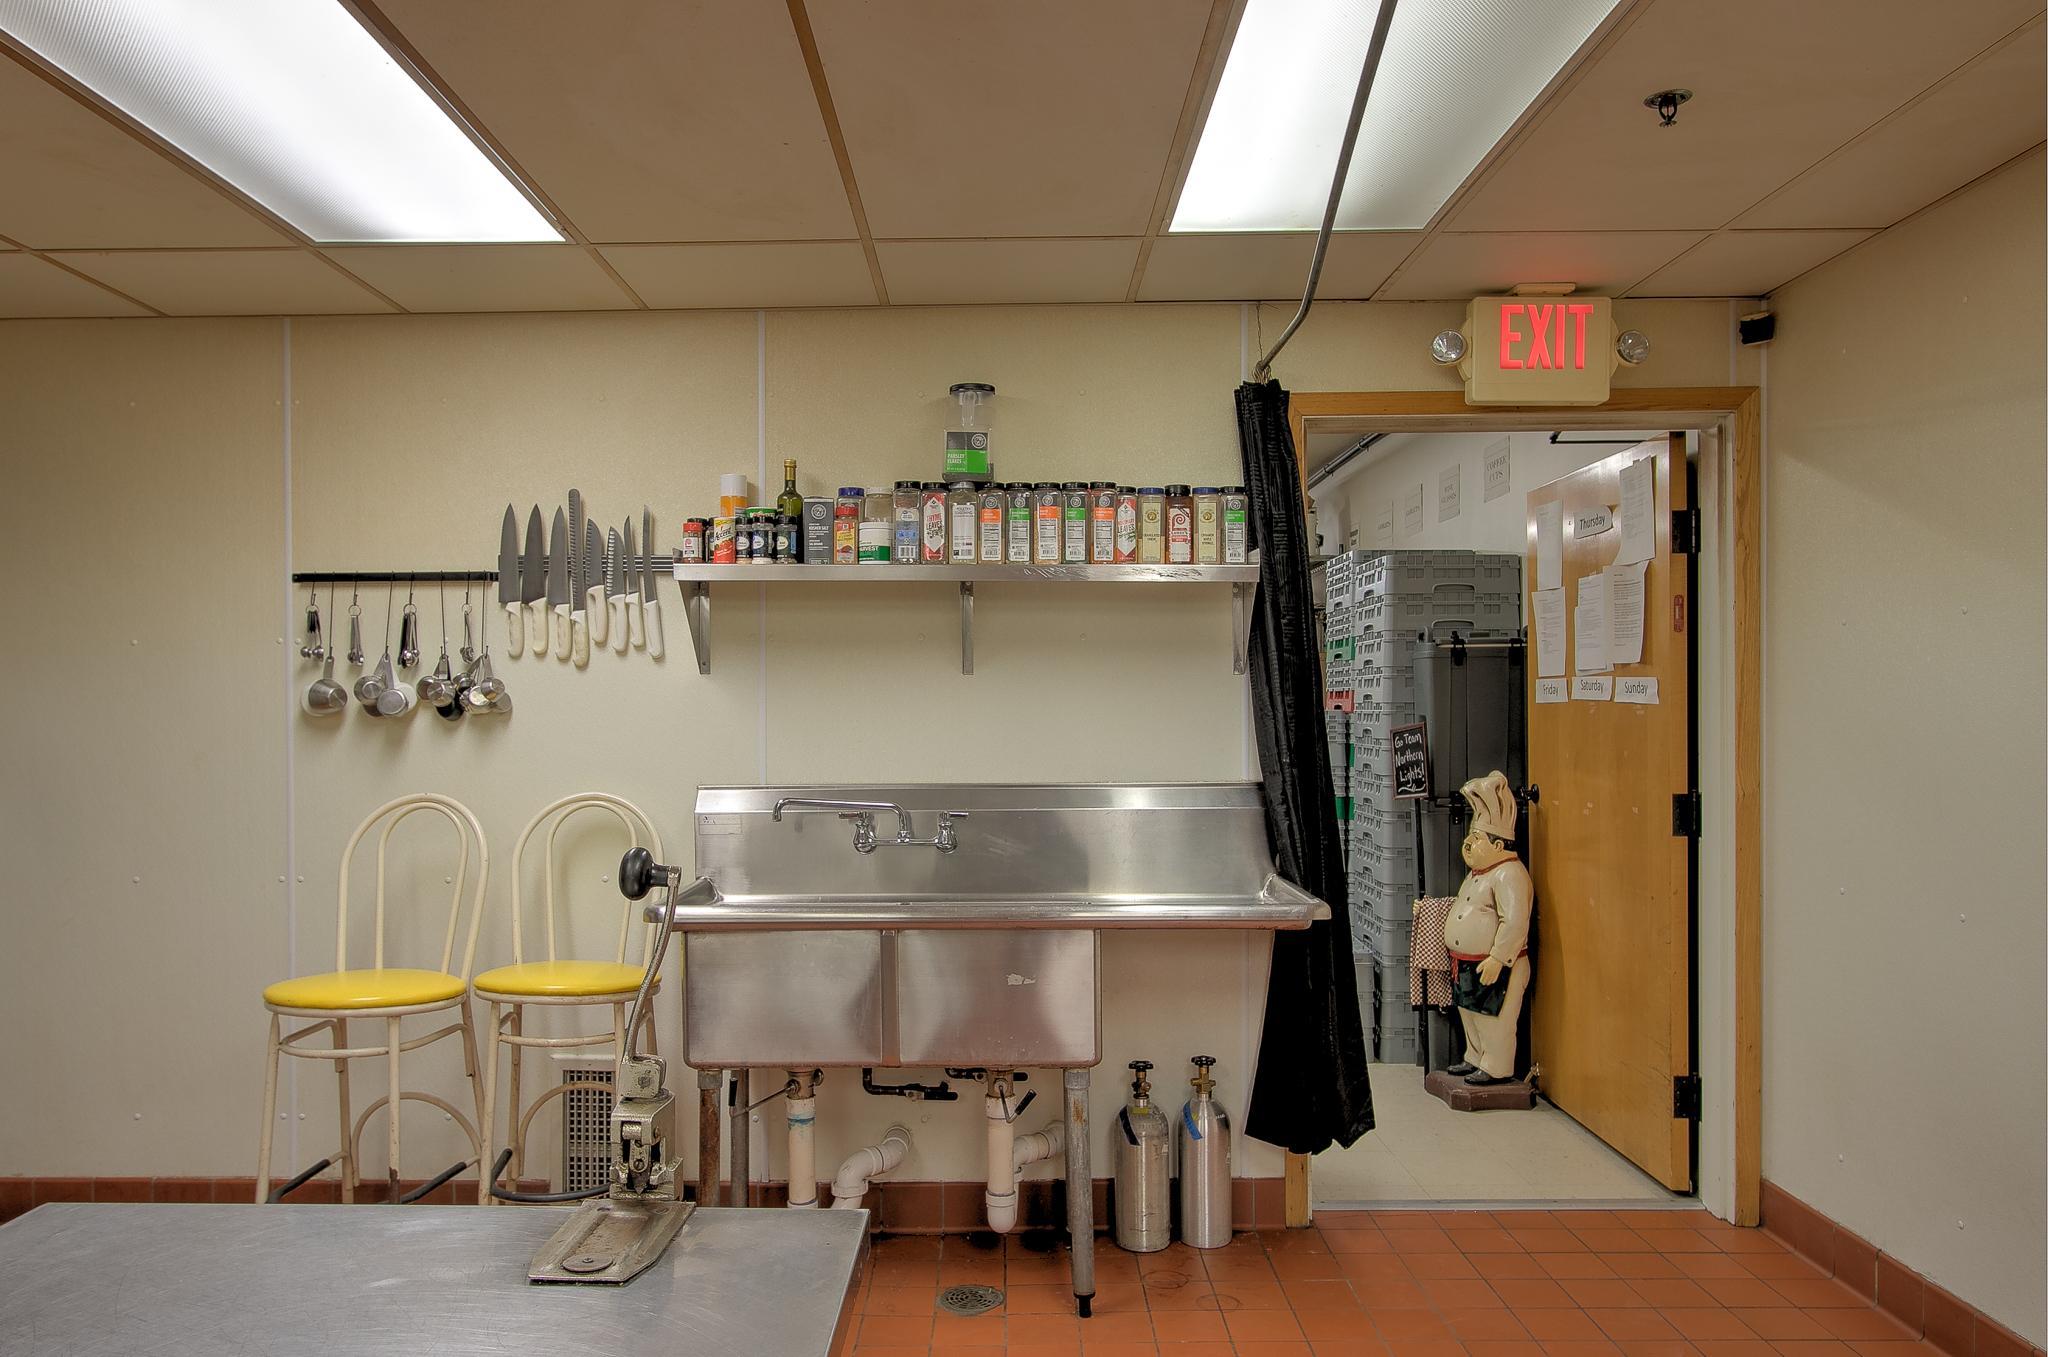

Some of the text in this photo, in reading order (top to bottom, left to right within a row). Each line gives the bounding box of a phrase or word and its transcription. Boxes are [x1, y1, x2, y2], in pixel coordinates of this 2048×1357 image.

[1500, 304, 1593, 369] EXIT
[1579, 512, 1605, 531] Thursday
[1542, 683, 1559, 696] Friday
[1580, 680, 1604, 693] Saturday
[1624, 681, 1649, 696] Sunday
[1395, 733, 1422, 748] Go Team
[1395, 749, 1424, 768] Northern
[1400, 762, 1425, 787] Lights!
